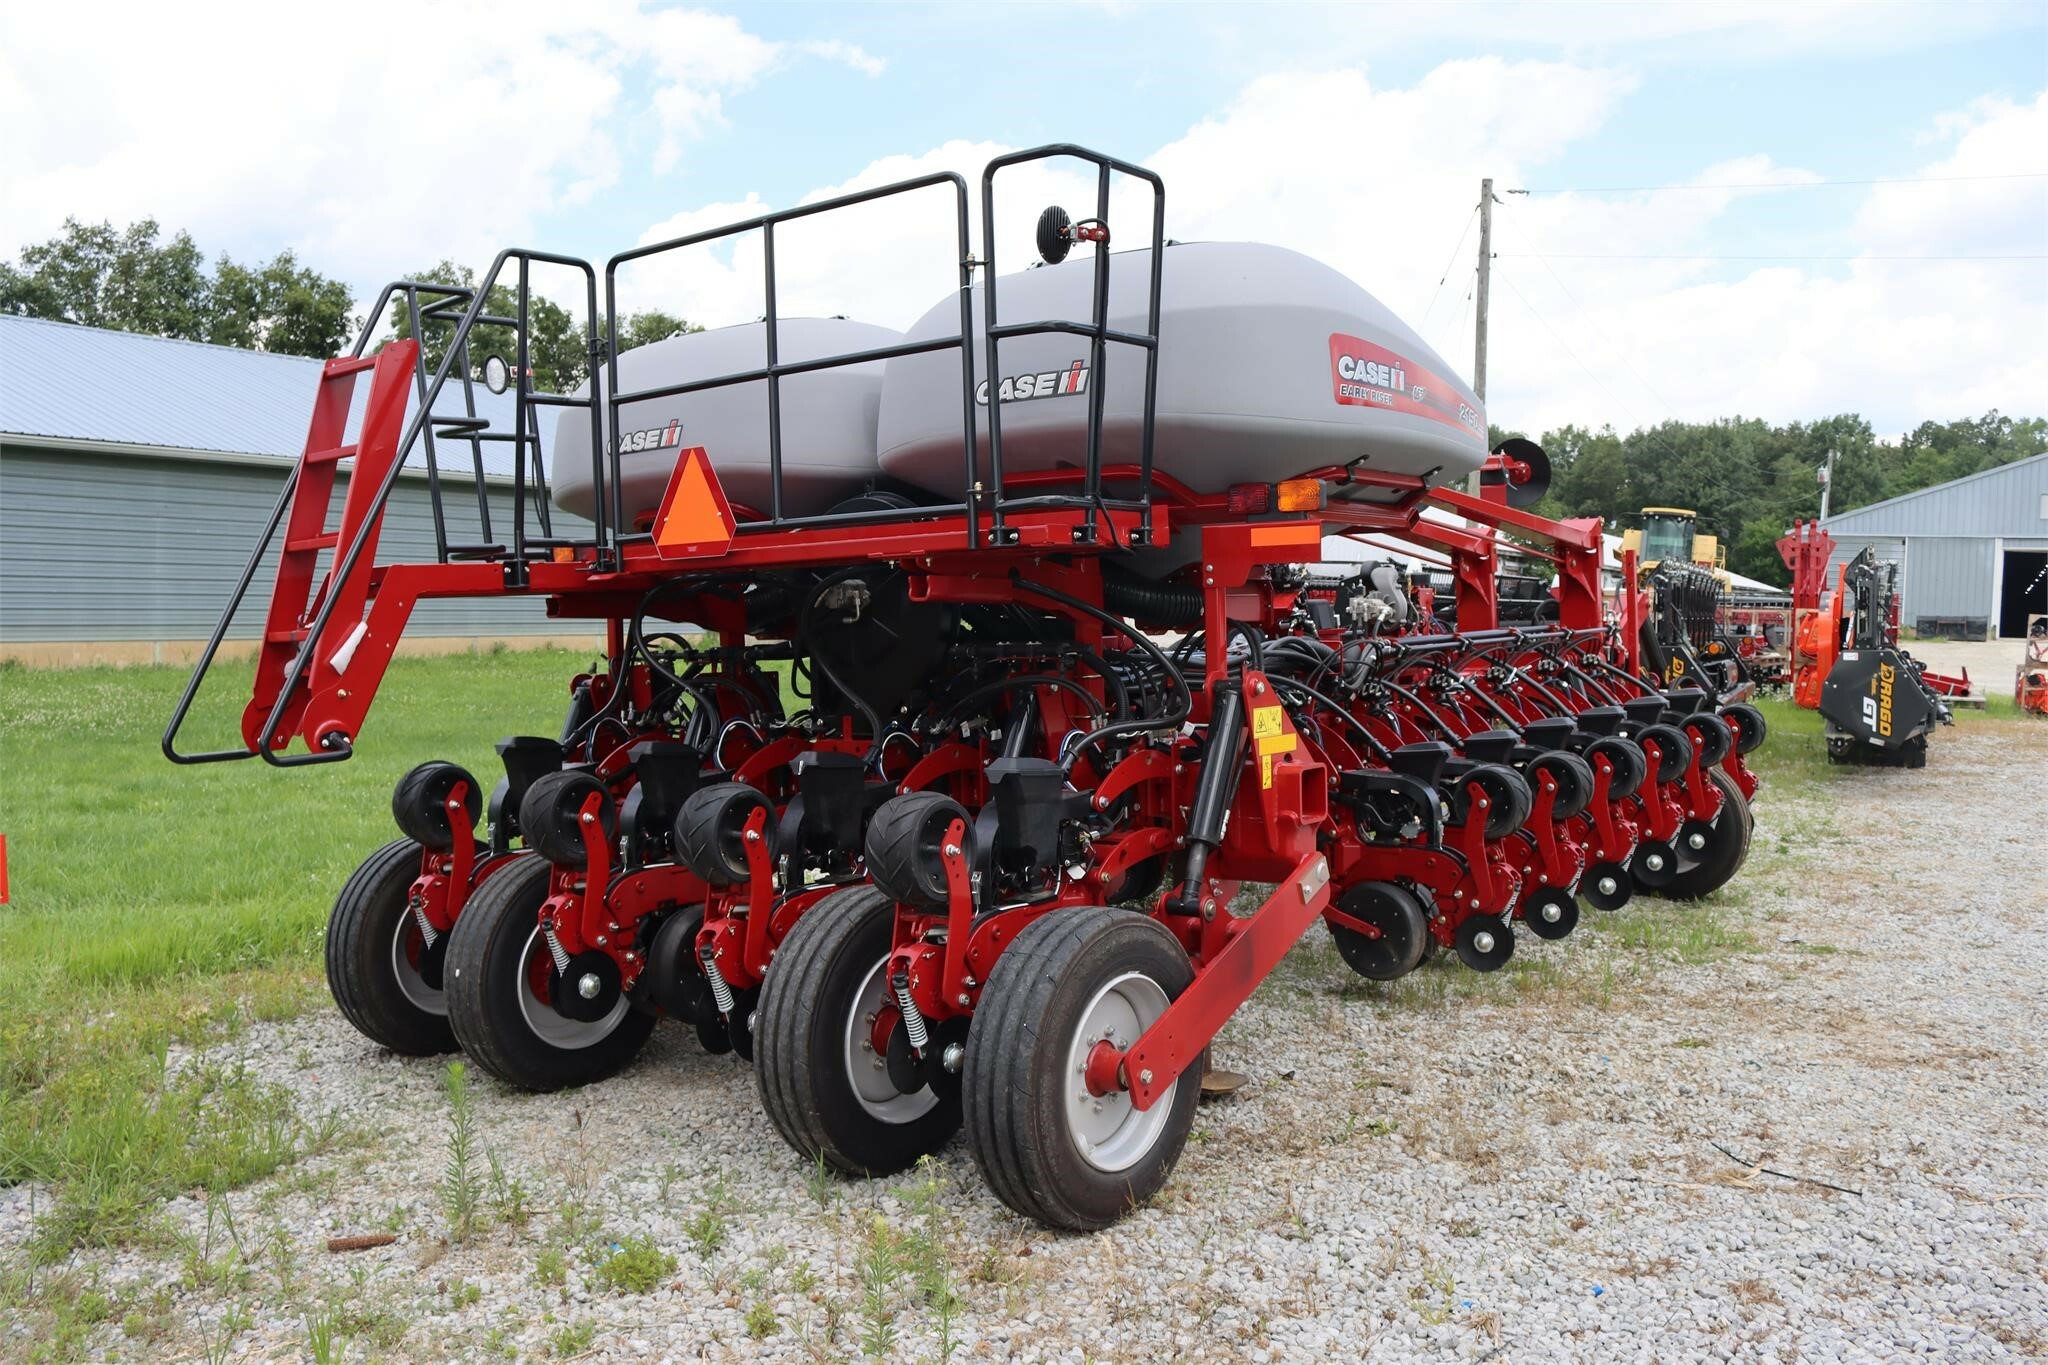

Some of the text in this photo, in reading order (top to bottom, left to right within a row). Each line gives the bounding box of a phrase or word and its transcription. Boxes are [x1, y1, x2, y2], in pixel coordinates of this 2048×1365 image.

[1338, 356, 1389, 388] CASE
[976, 372, 1058, 405] CASE
[1340, 383, 1370, 400] EARLY
[1370, 389, 1393, 406] RISER
[608, 428, 662, 455] ASE
[1862, 695, 1877, 733] GT
[1880, 662, 1895, 737] DRAGO
